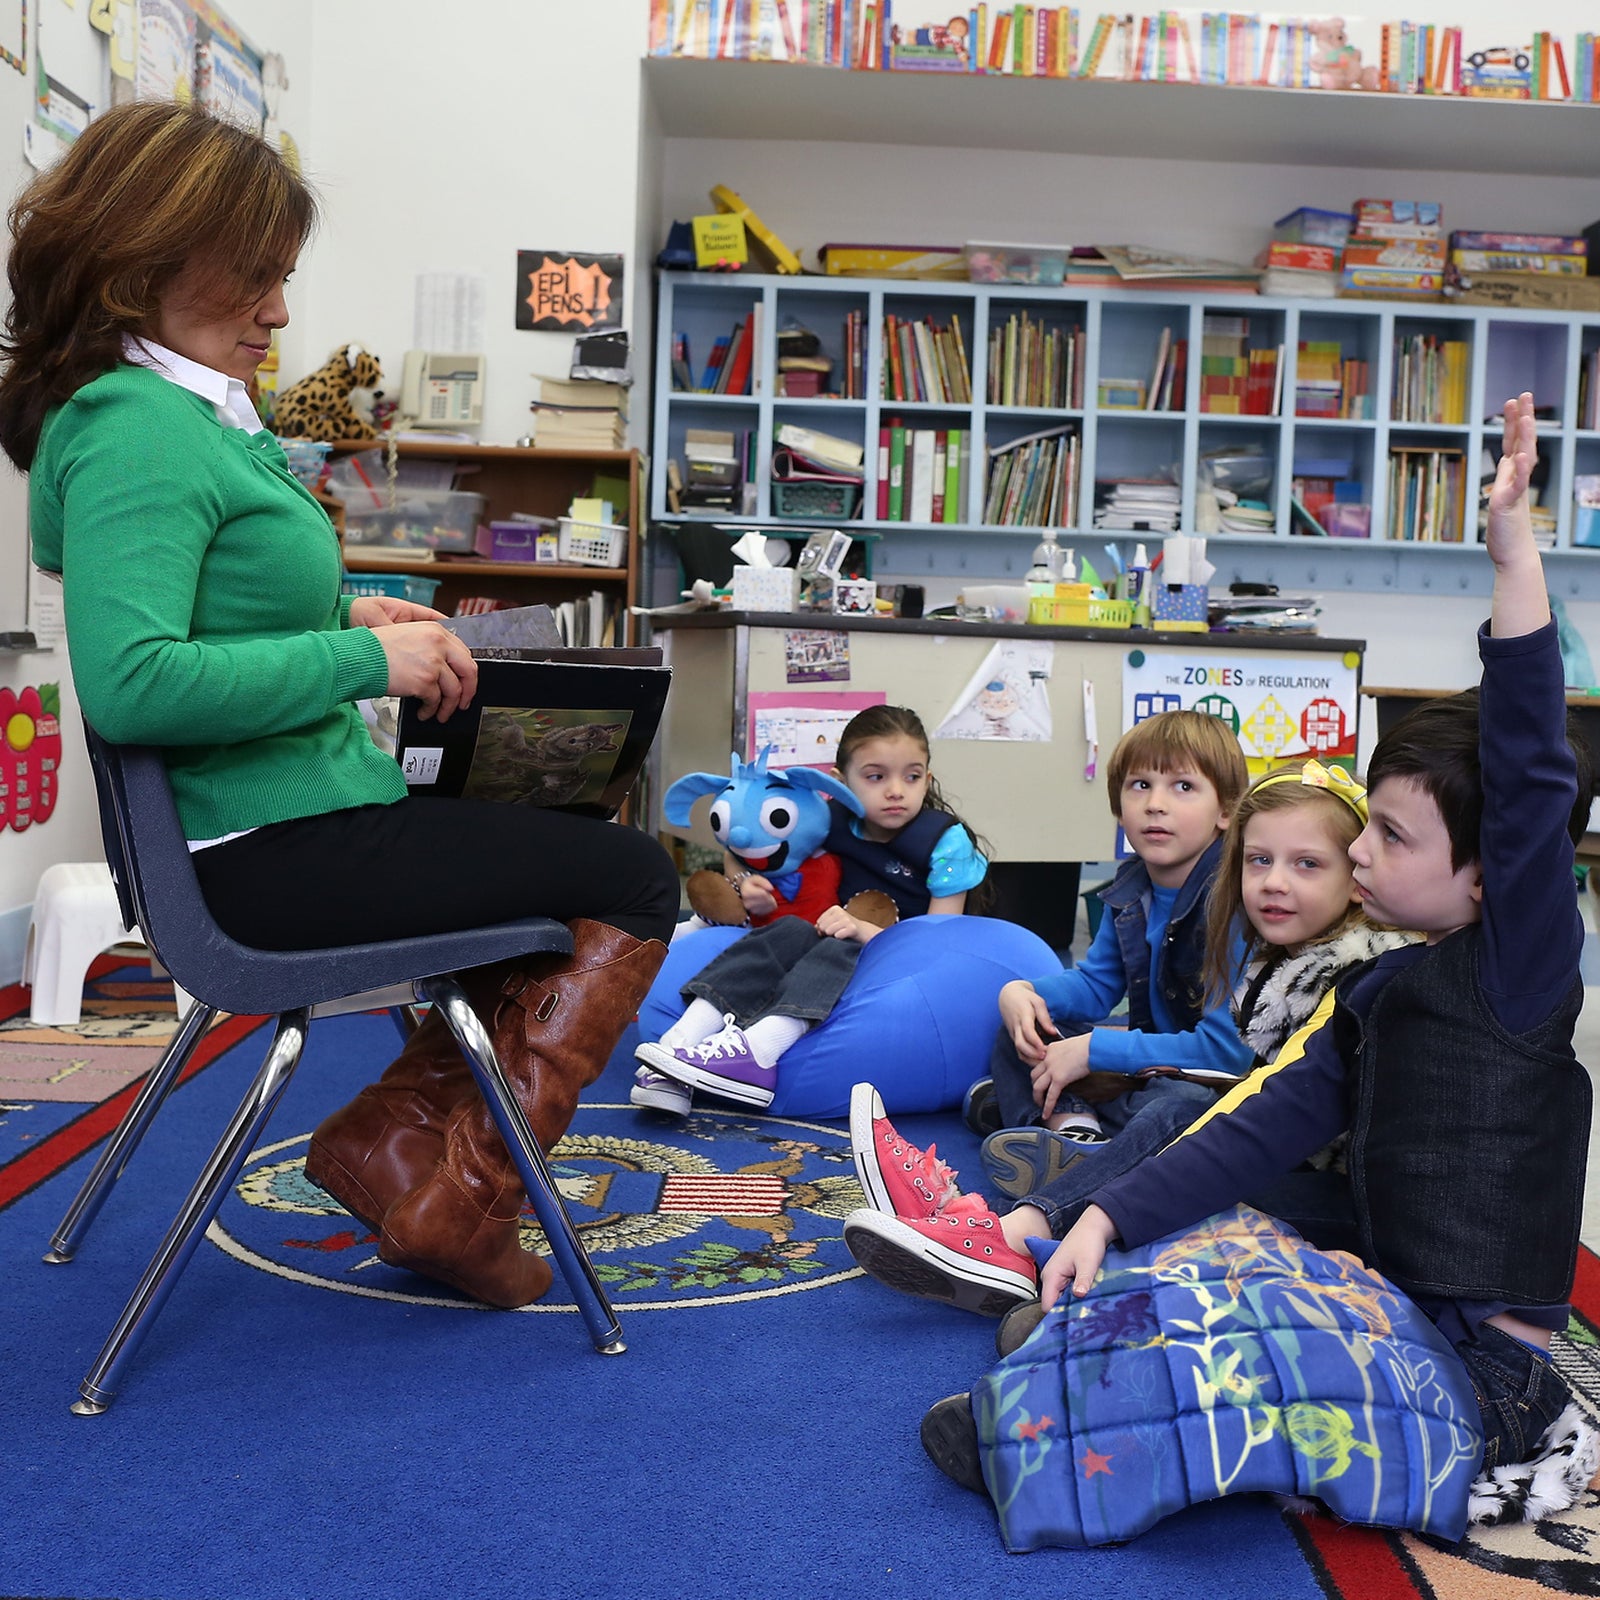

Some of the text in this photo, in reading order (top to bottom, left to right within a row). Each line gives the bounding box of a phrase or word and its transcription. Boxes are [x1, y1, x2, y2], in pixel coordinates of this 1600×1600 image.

[1166, 675, 1180, 685] THE
[1184, 667, 1243, 687] ZONES
[1258, 675, 1329, 689] REGULATION
